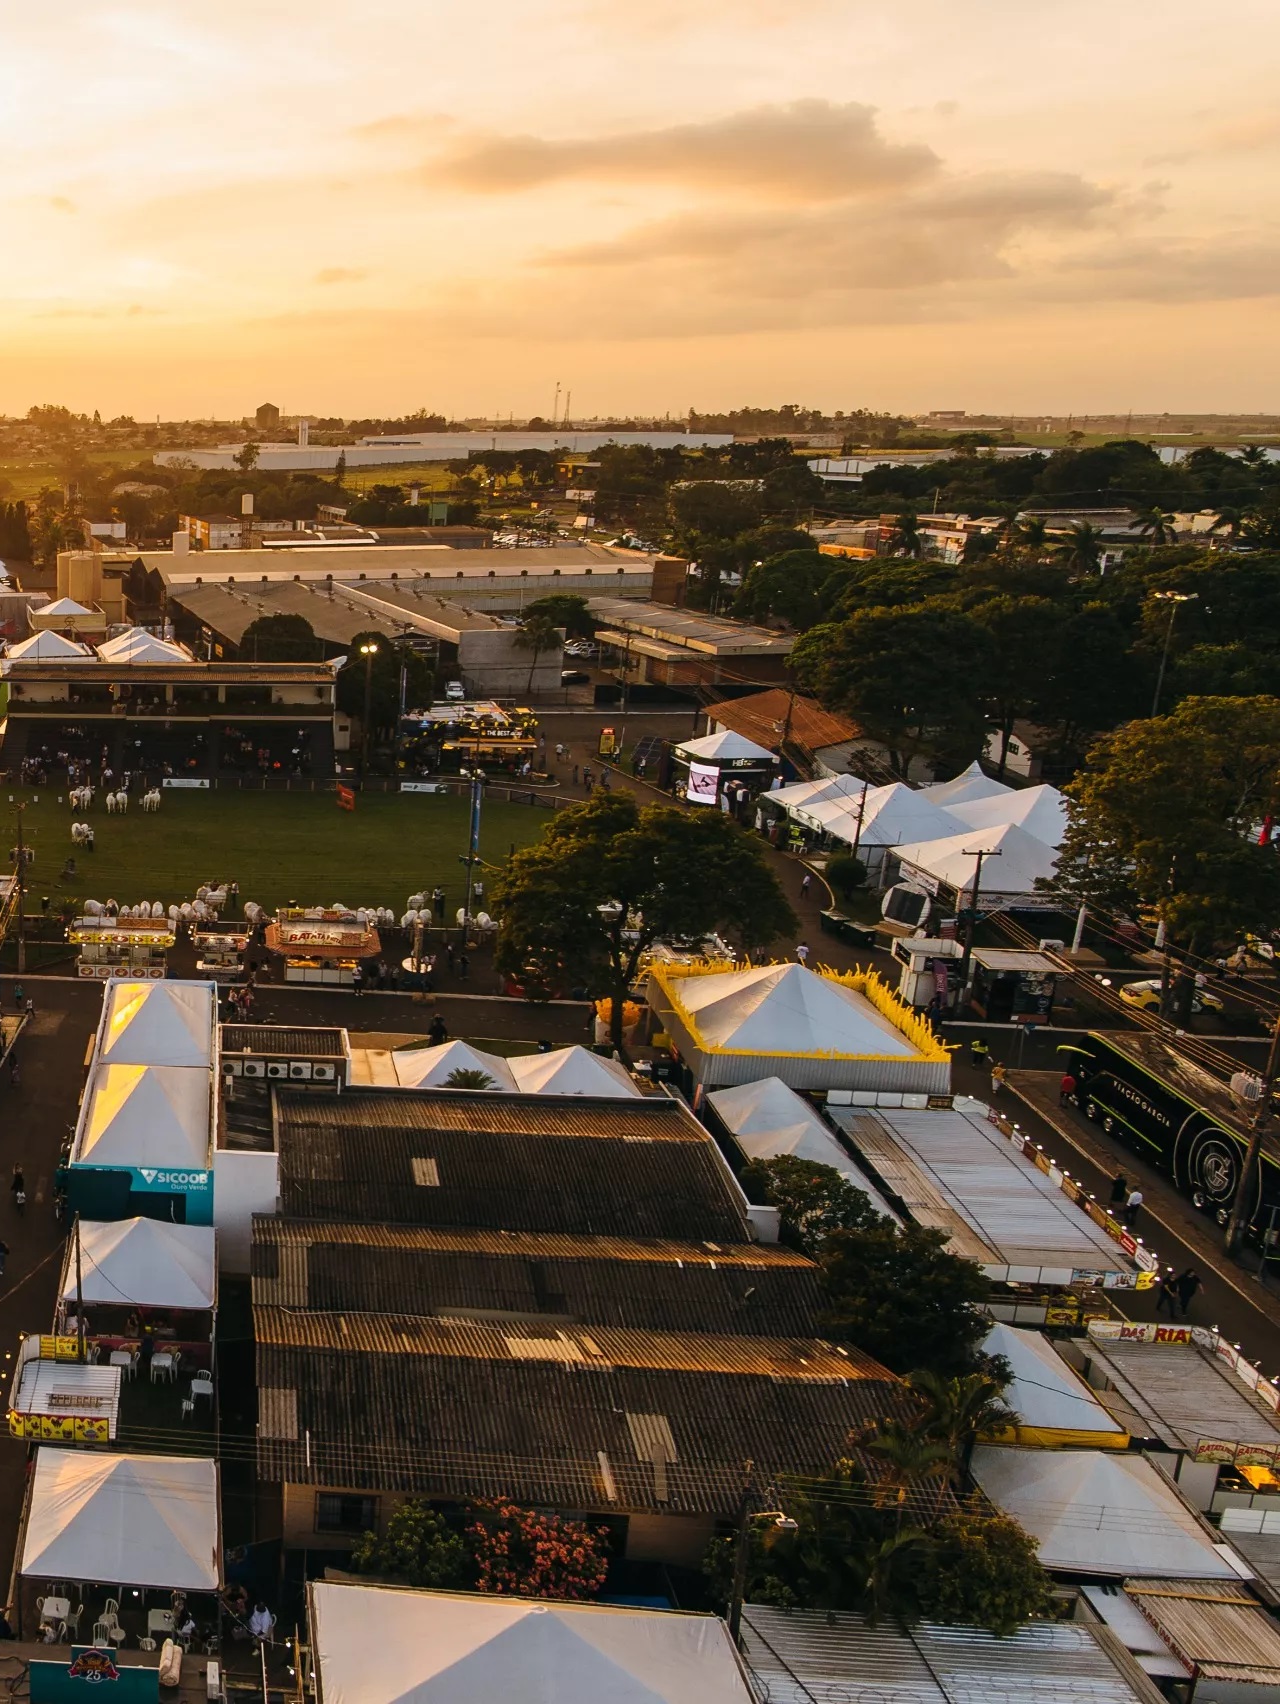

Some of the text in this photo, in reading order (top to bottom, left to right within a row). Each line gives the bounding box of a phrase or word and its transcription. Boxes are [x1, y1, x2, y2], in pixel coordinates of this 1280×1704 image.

[1113, 1080, 1170, 1128] VIAÇÃO GARCIA
[157, 1172, 208, 1184] SICOOB
[170, 1183, 187, 1191] Ouro
[86, 1669, 101, 1680] 25
